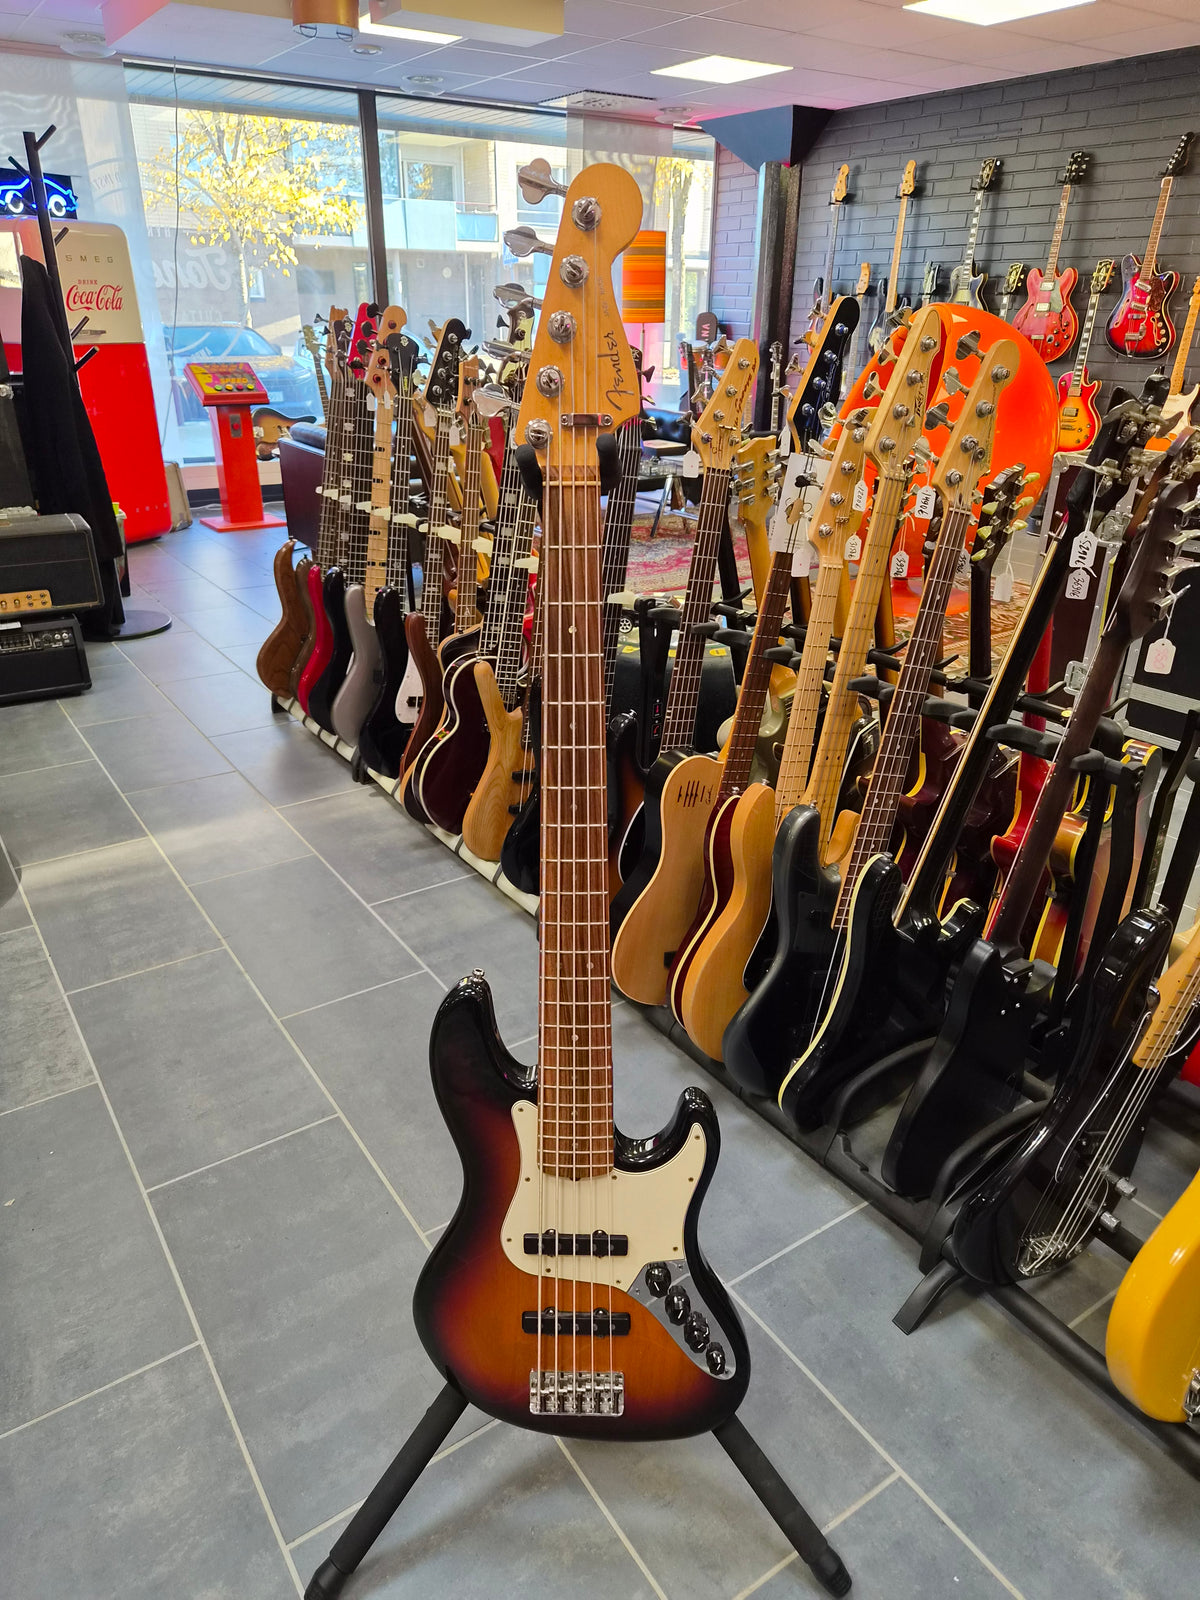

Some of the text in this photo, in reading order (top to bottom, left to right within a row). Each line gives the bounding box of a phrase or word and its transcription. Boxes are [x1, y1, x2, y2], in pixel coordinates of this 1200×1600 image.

[65, 254, 114, 264] SMEG
[65, 284, 123, 312] Coca-Cola
[597, 331, 635, 411] Fender
